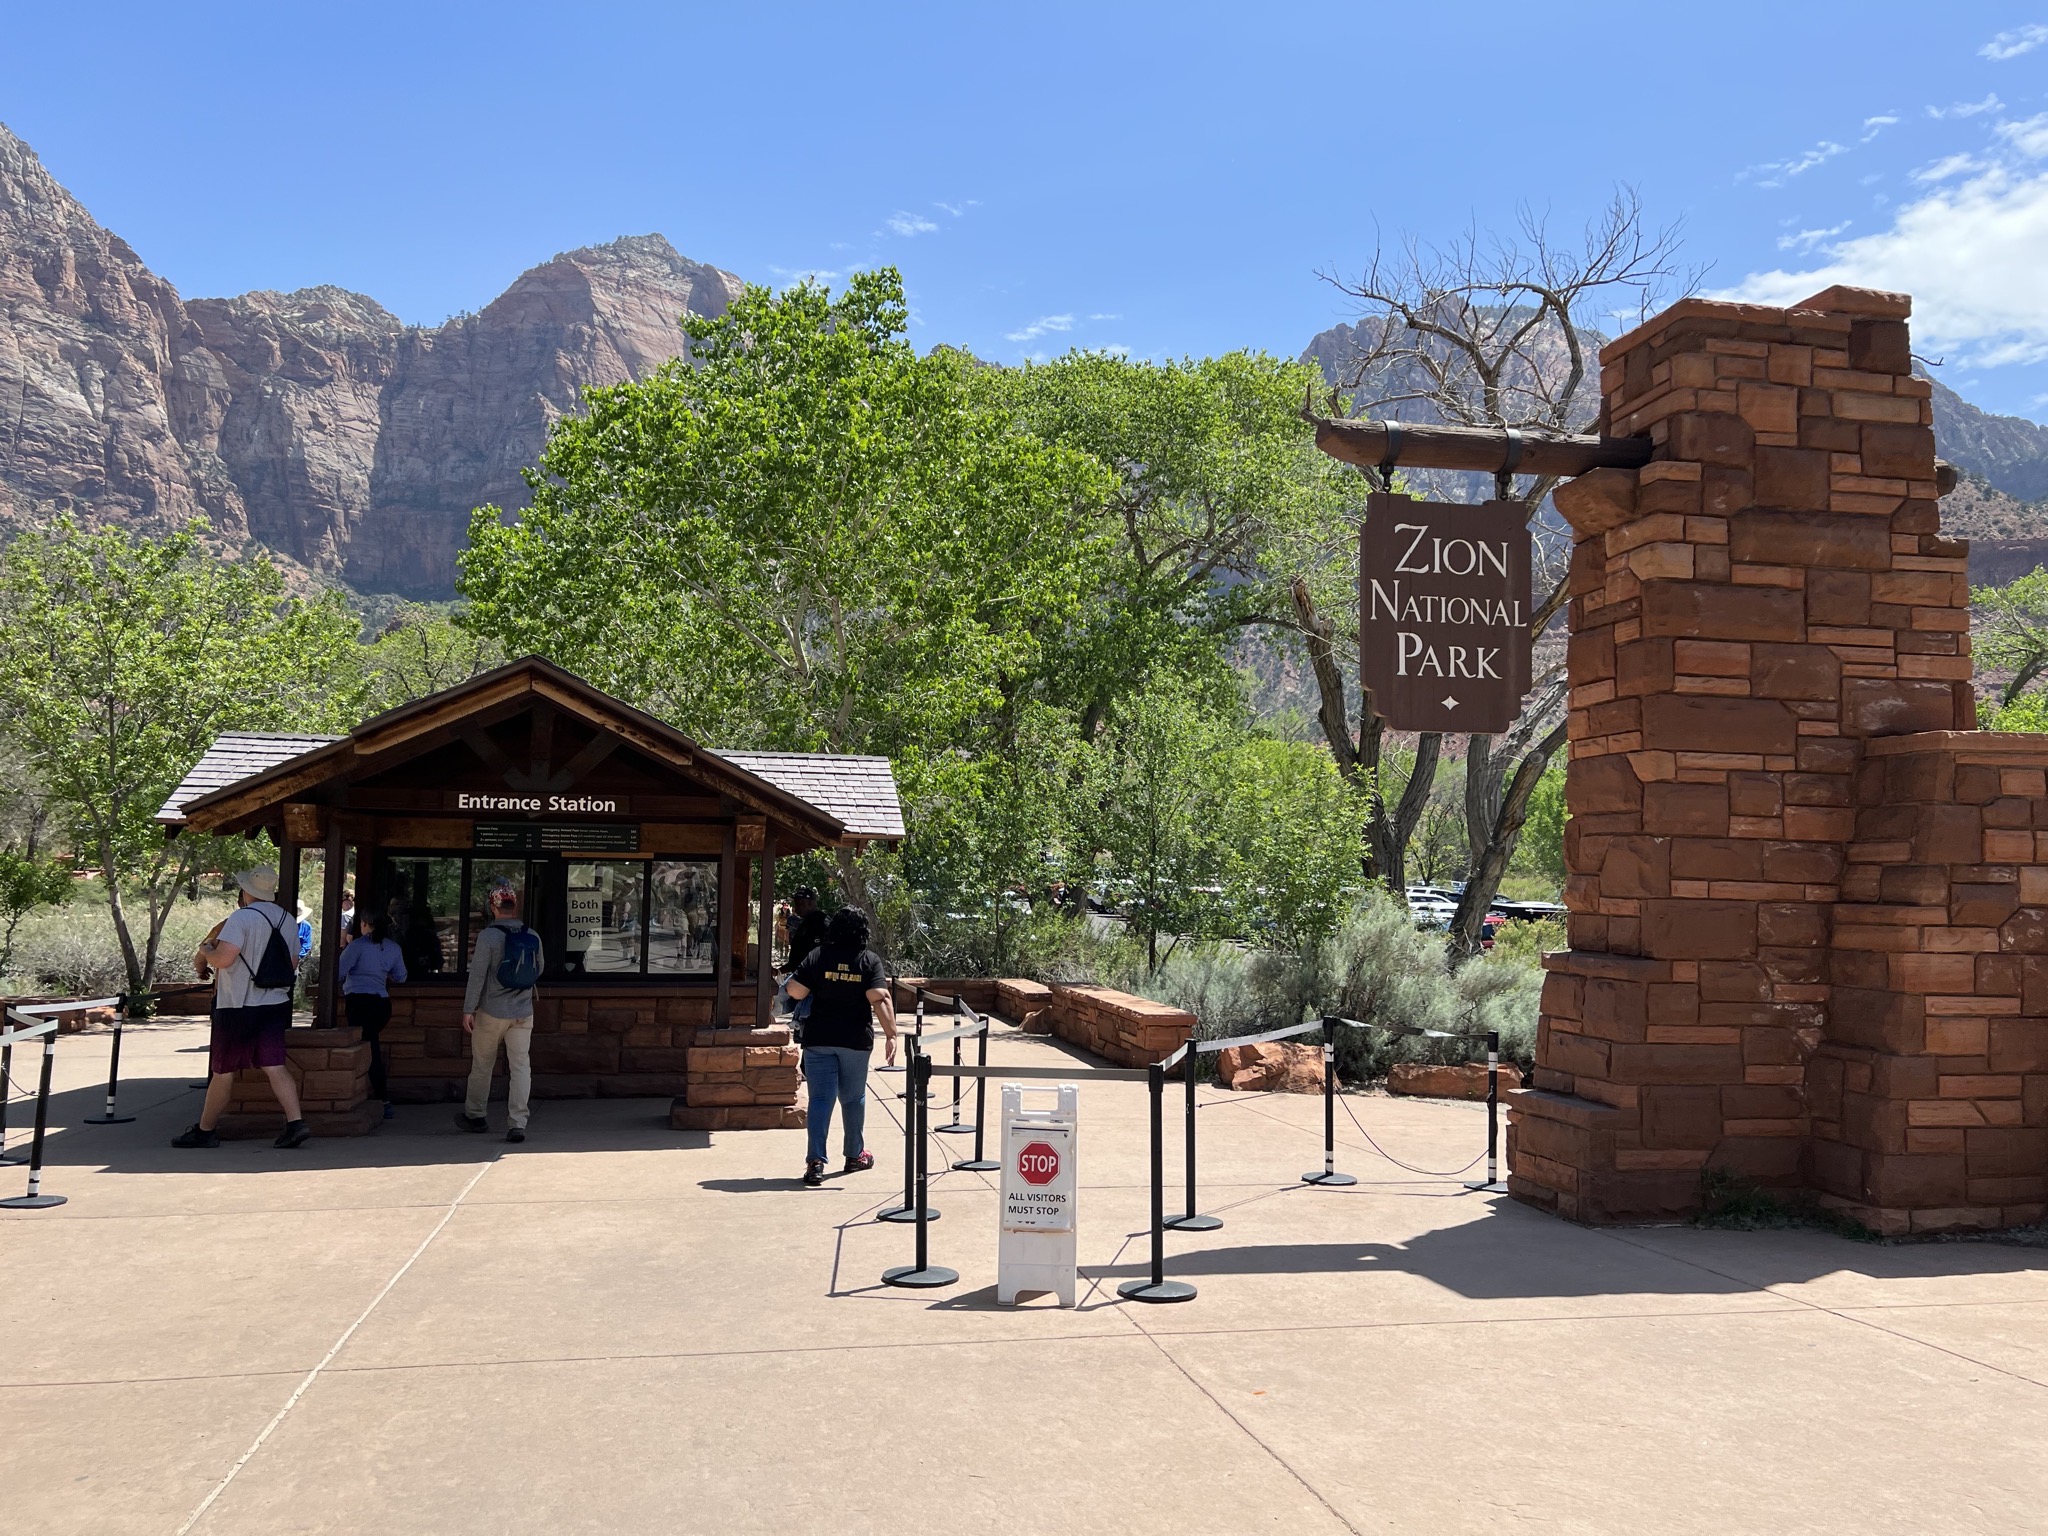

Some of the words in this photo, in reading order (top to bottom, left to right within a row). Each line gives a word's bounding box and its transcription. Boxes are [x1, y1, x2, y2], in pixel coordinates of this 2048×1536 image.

[1394, 523, 1508, 579] ZION
[1370, 578, 1527, 627] NATIONAL
[1396, 632, 1503, 680] PARK
[458, 793, 541, 811] Entrance
[548, 795, 616, 812] Station
[571, 899, 599, 909] Both
[568, 914, 601, 924] Lanes
[568, 928, 600, 940] Open
[1021, 1154, 1057, 1173] STOP
[1008, 1192, 1025, 1201] ALL
[1027, 1193, 1067, 1203] VISITORS
[1008, 1205, 1034, 1214] MUST
[1036, 1206, 1059, 1216] STOP
